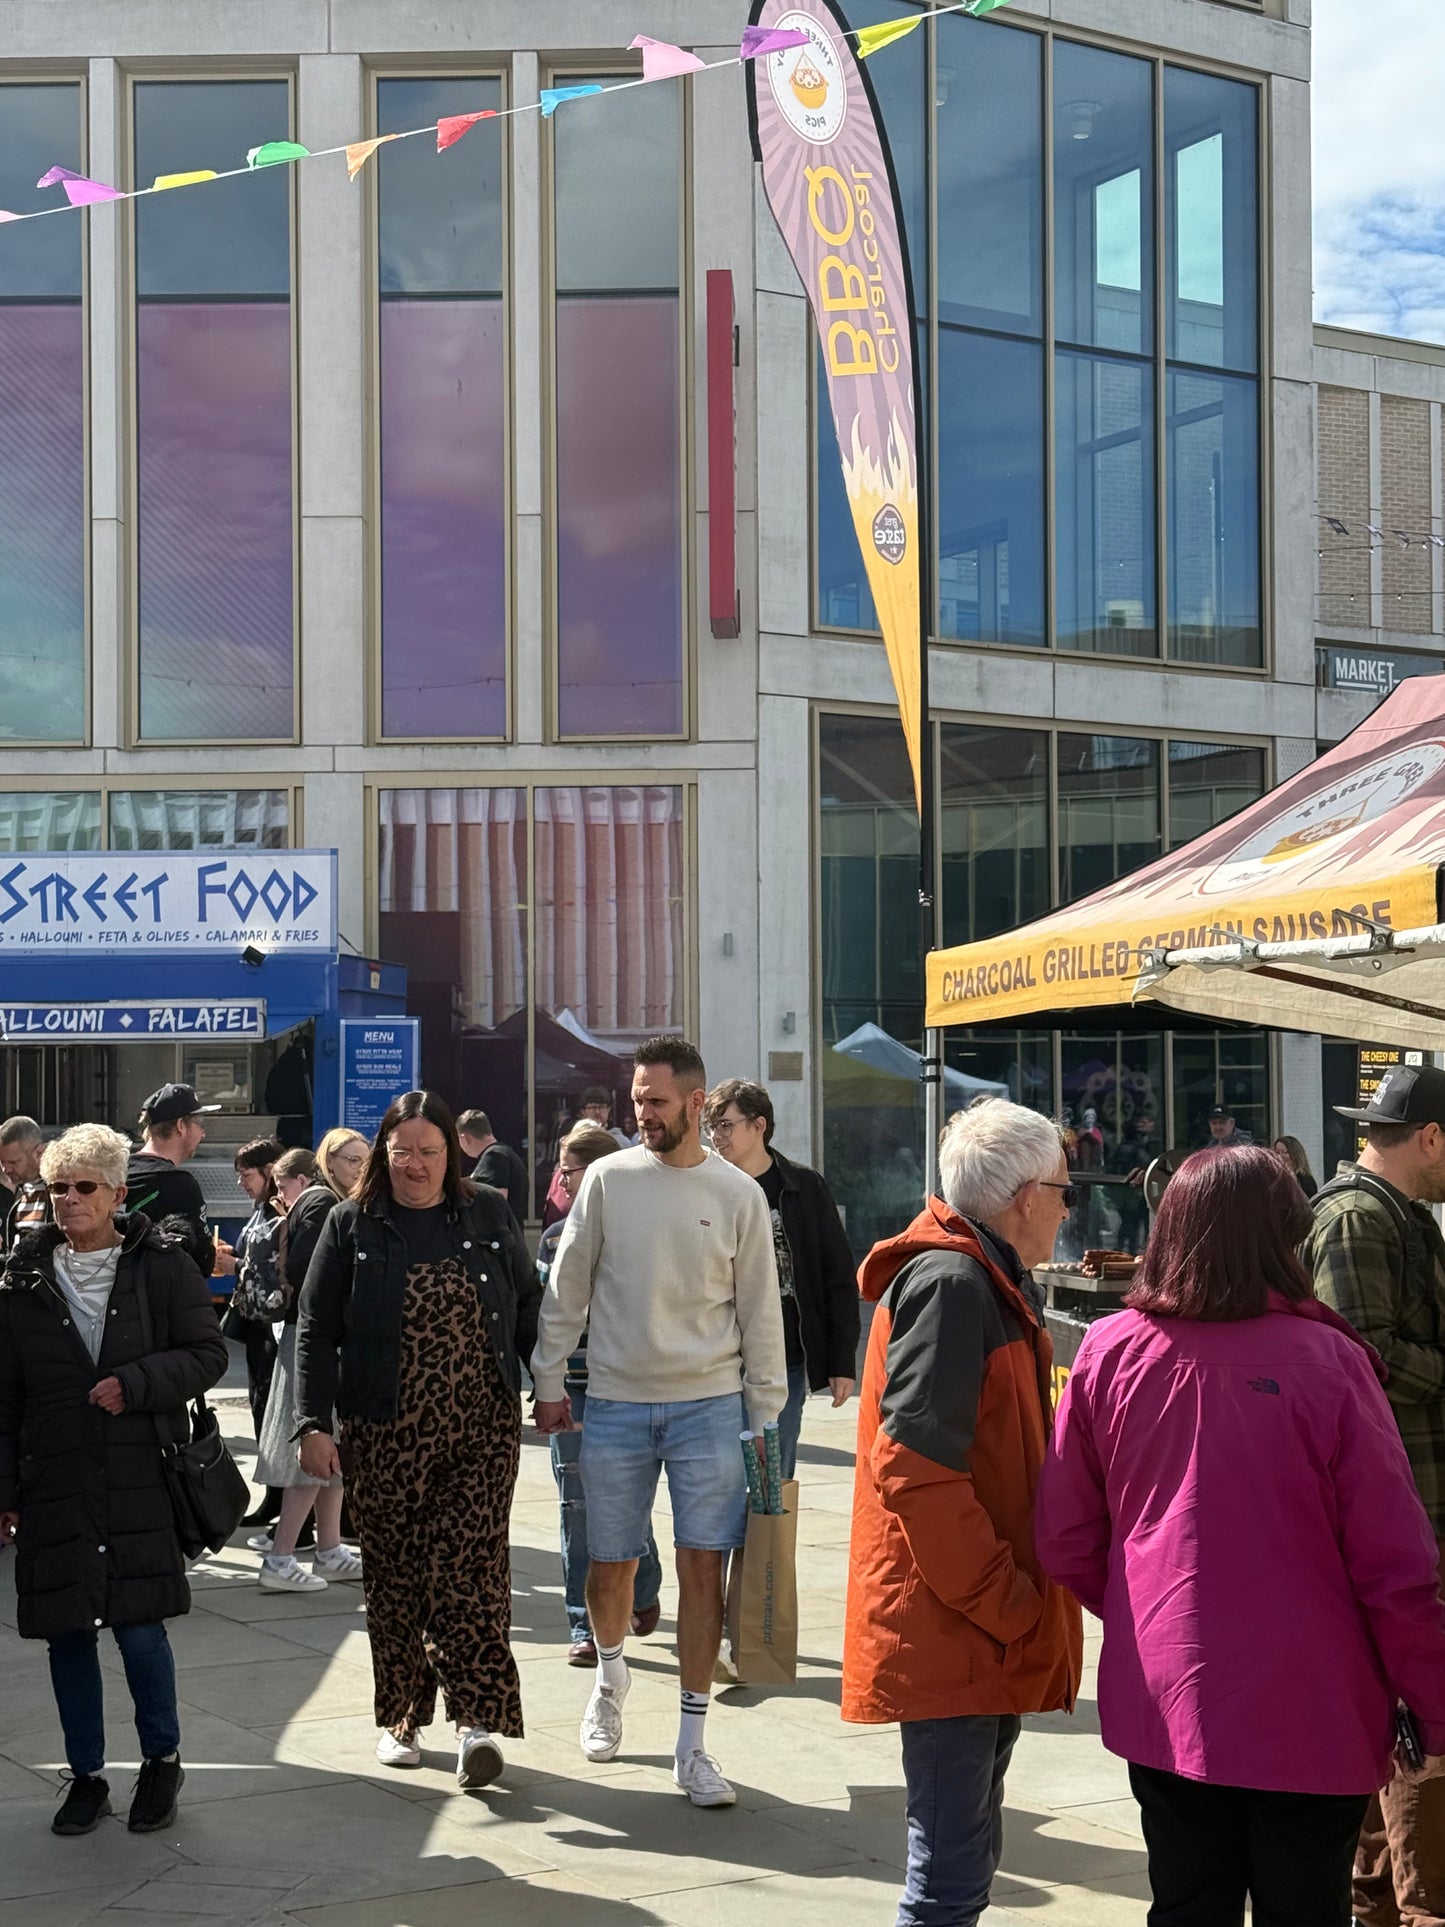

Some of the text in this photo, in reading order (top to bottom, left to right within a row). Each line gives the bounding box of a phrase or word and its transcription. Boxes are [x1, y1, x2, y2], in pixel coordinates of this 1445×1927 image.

[1335, 656, 1395, 685] MARKET
[1296, 766, 1394, 819] THREE
[0, 860, 319, 925] STREET FOOD
[20, 929, 319, 943] HALLOUMI FETA & OLIVES CALAMARI & FRIES
[942, 954, 1037, 1002] CHARCOAL
[1042, 939, 1129, 984] GRILLED
[148, 1008, 258, 1032] FALAFEL
[364, 1031, 394, 1042] MENU
[1361, 1051, 1399, 1062] THE CHEESY ONE
[763, 1561, 776, 1646] primark.com
